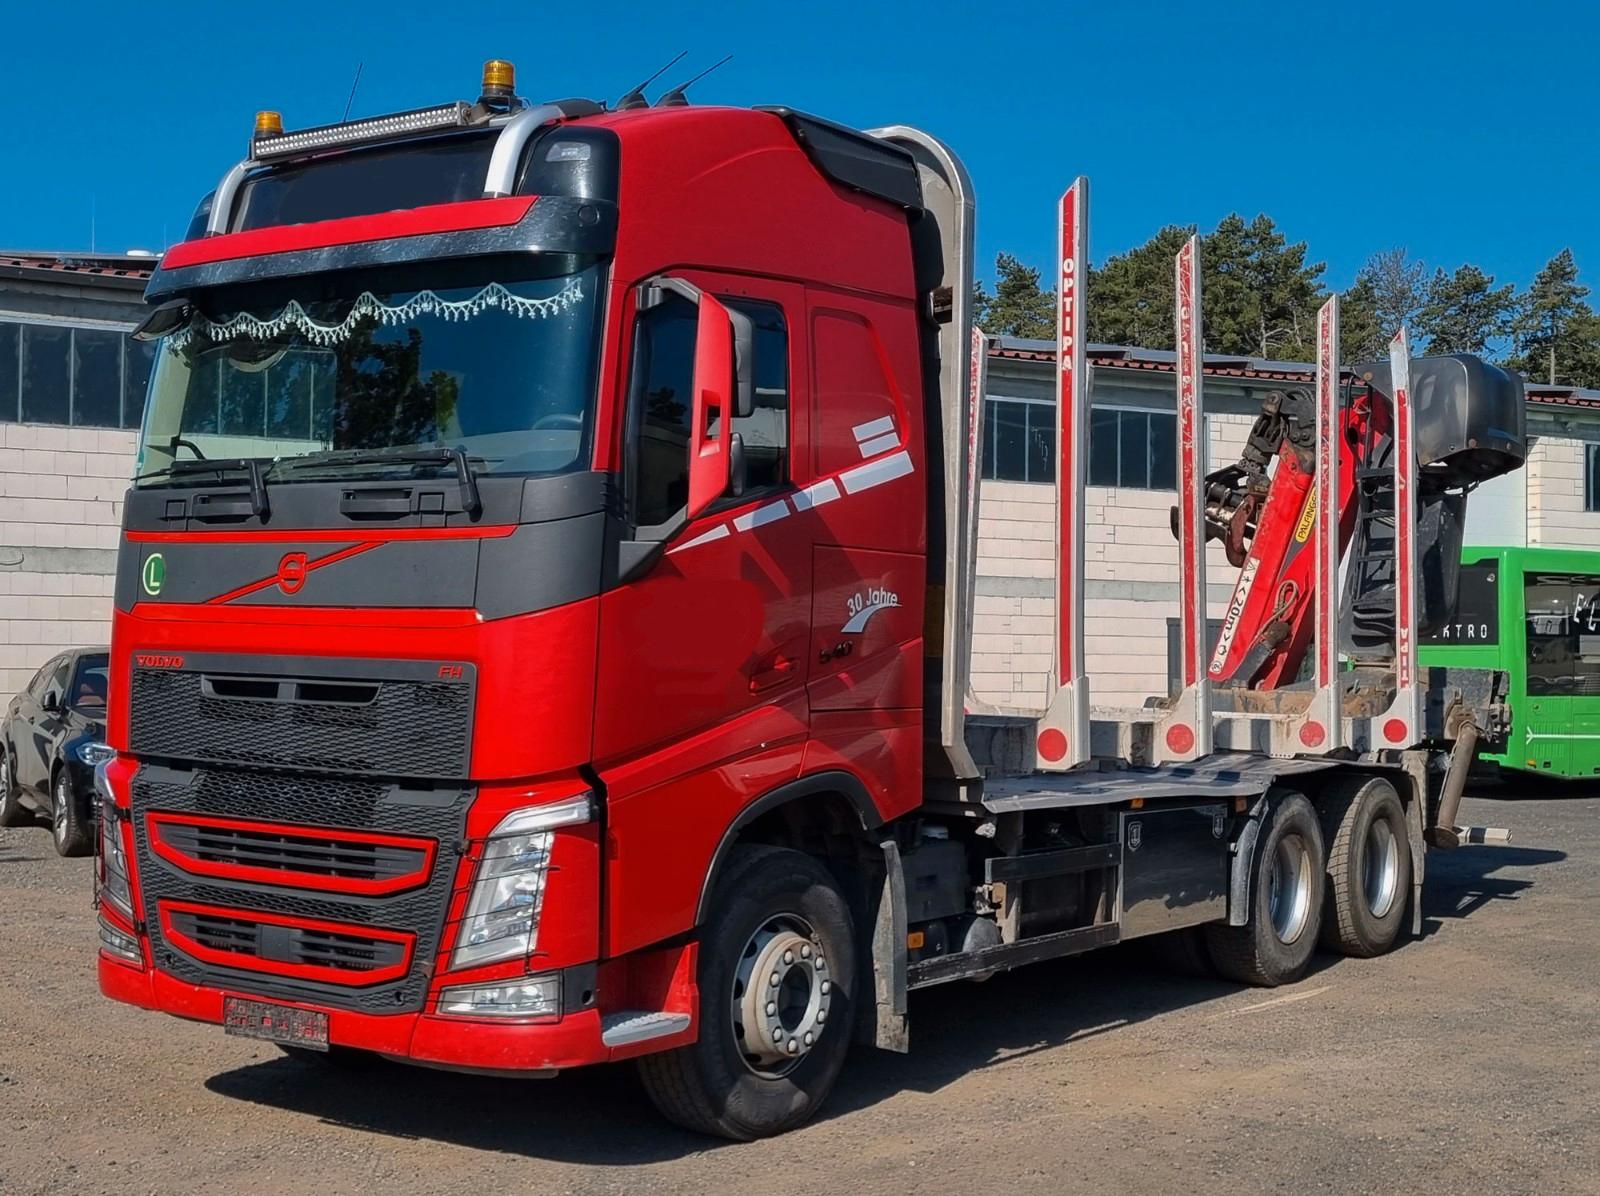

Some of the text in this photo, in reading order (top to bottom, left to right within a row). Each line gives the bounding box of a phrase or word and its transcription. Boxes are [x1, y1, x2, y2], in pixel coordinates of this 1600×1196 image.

[1062, 258, 1074, 370] OPTIPA
[150, 562, 160, 587] L
[847, 587, 898, 617] 30 Jahre
[1432, 624, 1488, 639] KTRO
[136, 655, 185, 669] VOLVO
[438, 665, 464, 679] FH
